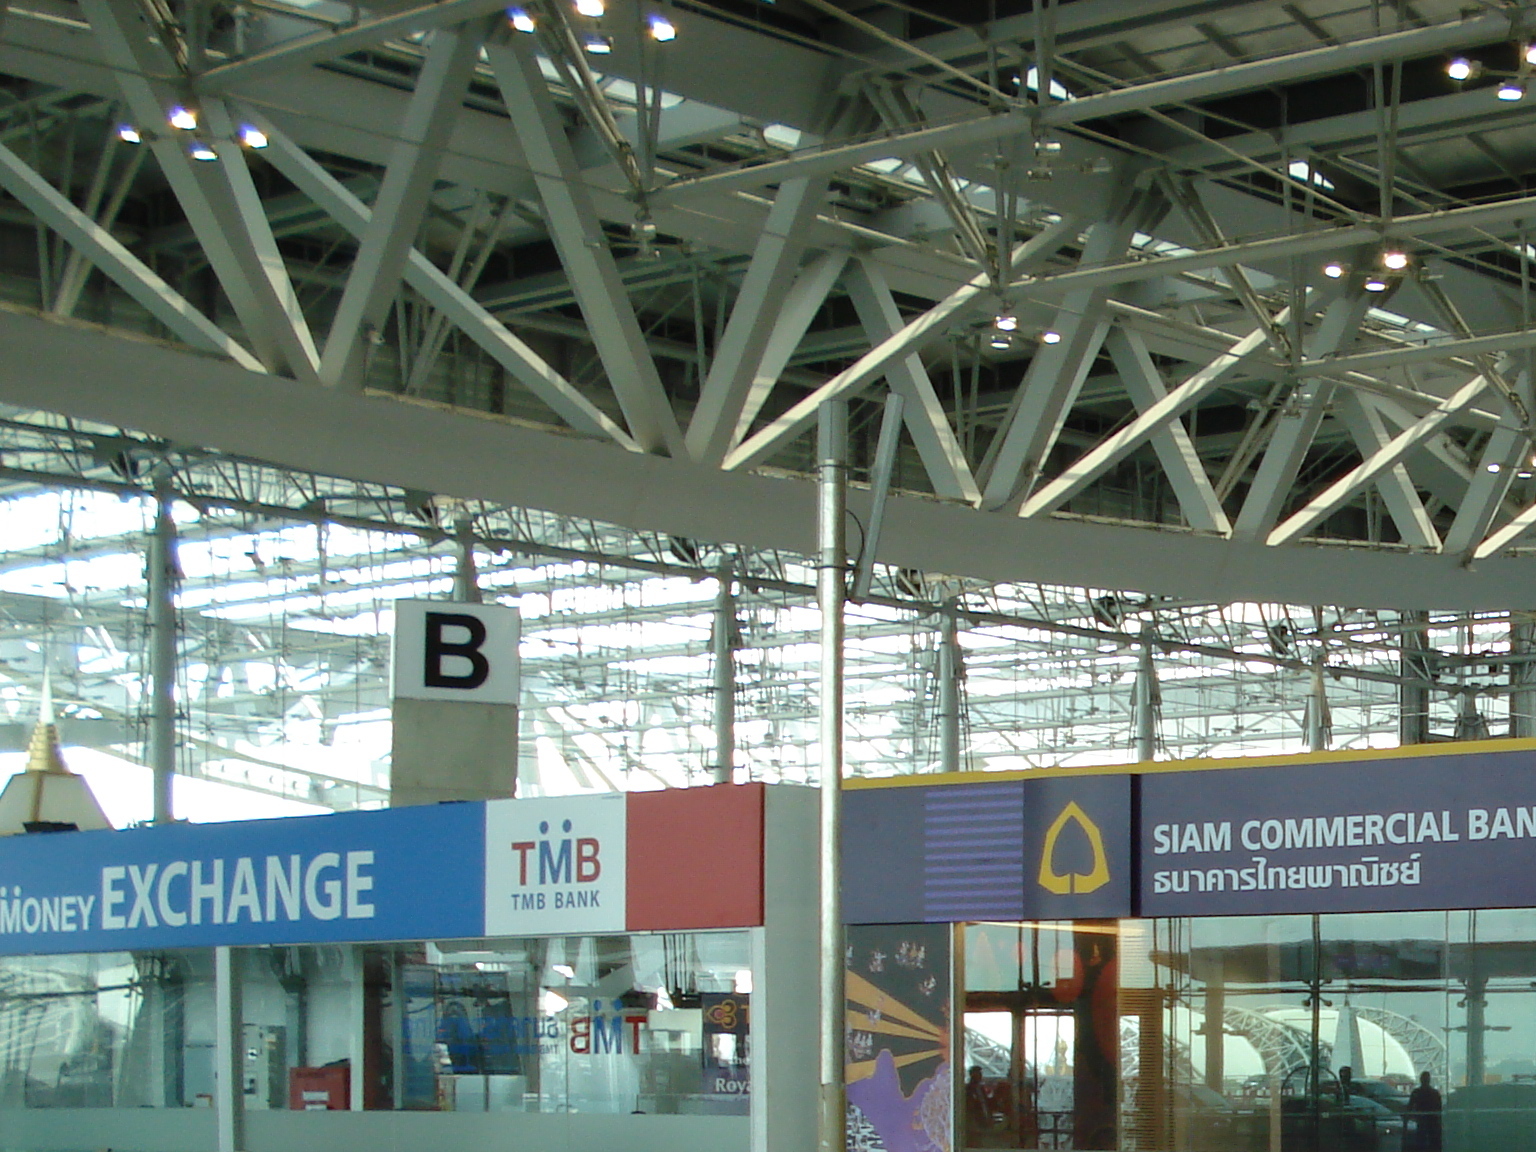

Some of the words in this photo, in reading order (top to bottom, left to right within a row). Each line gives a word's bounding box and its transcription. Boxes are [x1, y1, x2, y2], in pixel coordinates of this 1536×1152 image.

[424, 611, 489, 689] B
[1153, 822, 1232, 855] SIAM
[1240, 810, 1459, 852] COMMERCIAL
[511, 836, 601, 887] TMB
[1153, 853, 1422, 894] ธนาคารไทยพาณิชย์
[102, 850, 375, 930] EXCHANGE
[511, 892, 546, 911] TMB
[555, 889, 600, 910] BANK
